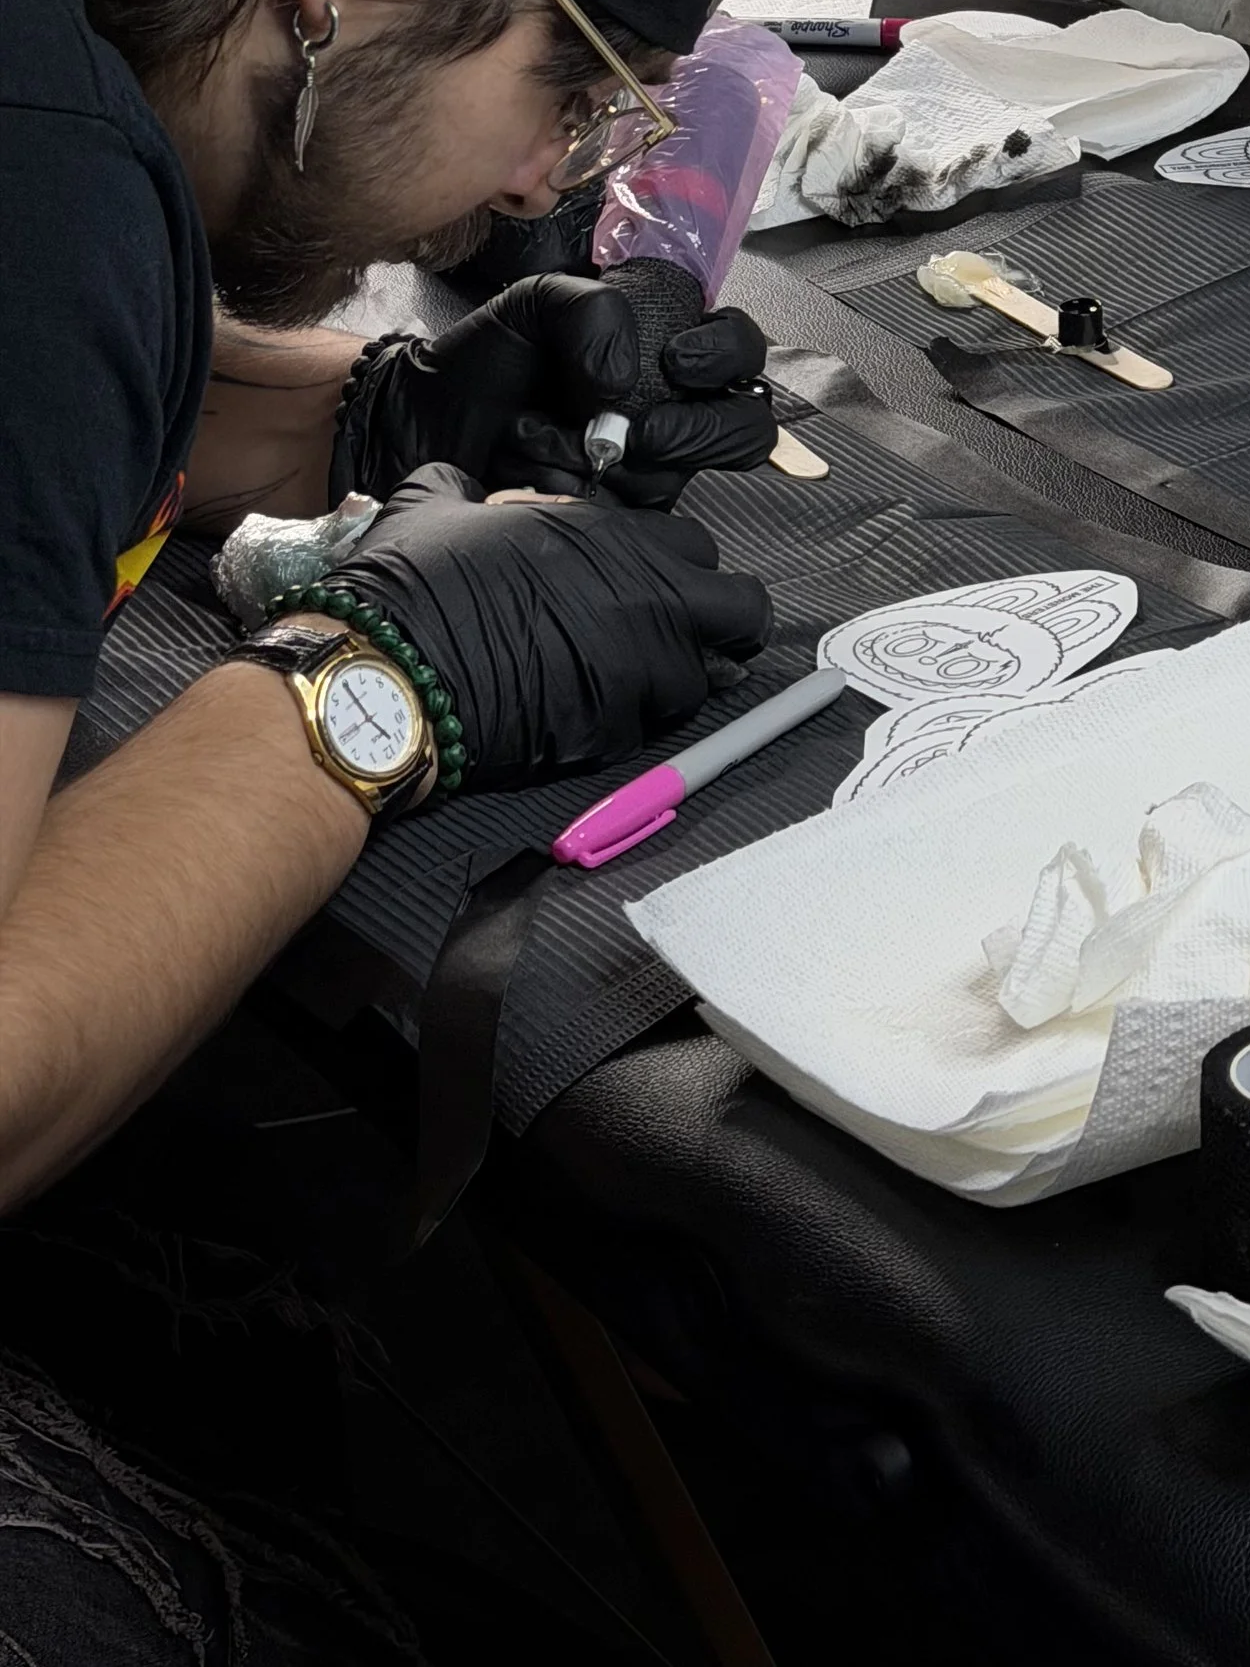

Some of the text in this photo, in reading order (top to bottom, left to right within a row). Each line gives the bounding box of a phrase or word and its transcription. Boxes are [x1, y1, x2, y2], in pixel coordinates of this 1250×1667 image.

[790, 20, 850, 38] Sharpie
[1021, 581, 1104, 619] THE MONSTERS
[394, 708, 406, 724] 10
[383, 744, 396, 760] 12
